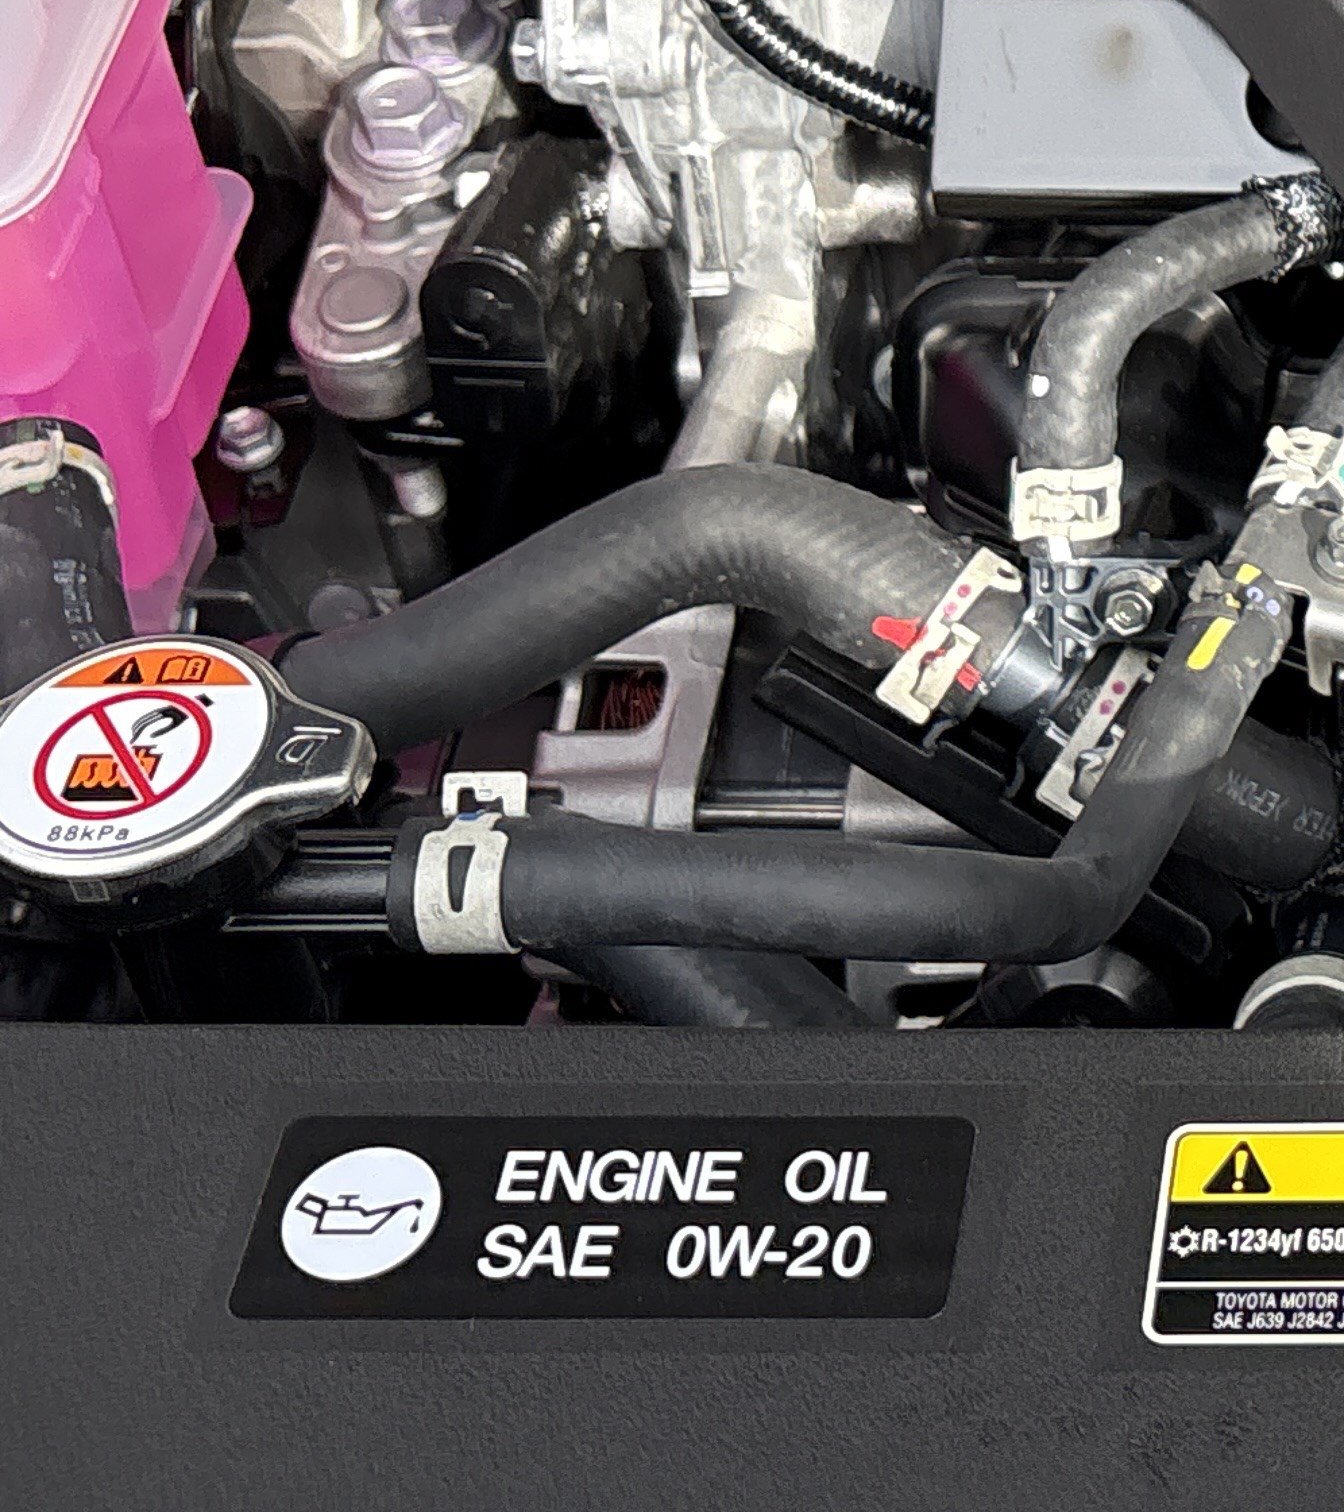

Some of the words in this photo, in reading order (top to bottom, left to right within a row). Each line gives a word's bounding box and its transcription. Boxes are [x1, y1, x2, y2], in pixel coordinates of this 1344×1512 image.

[46, 825, 130, 843] 88kPa
[495, 1149, 743, 1203] ENGINE
[784, 1150, 888, 1203] OIL
[477, 1224, 620, 1279] SAE
[666, 1225, 872, 1279] 0W-20
[1202, 1227, 1302, 1257] R-1234yf
[1215, 1291, 1277, 1310] TOYOTA
[1280, 1291, 1339, 1310] MOTOR
[1212, 1311, 1244, 1330] SAE
[1246, 1311, 1285, 1330] J639
[1286, 1311, 1335, 1330] J2842
